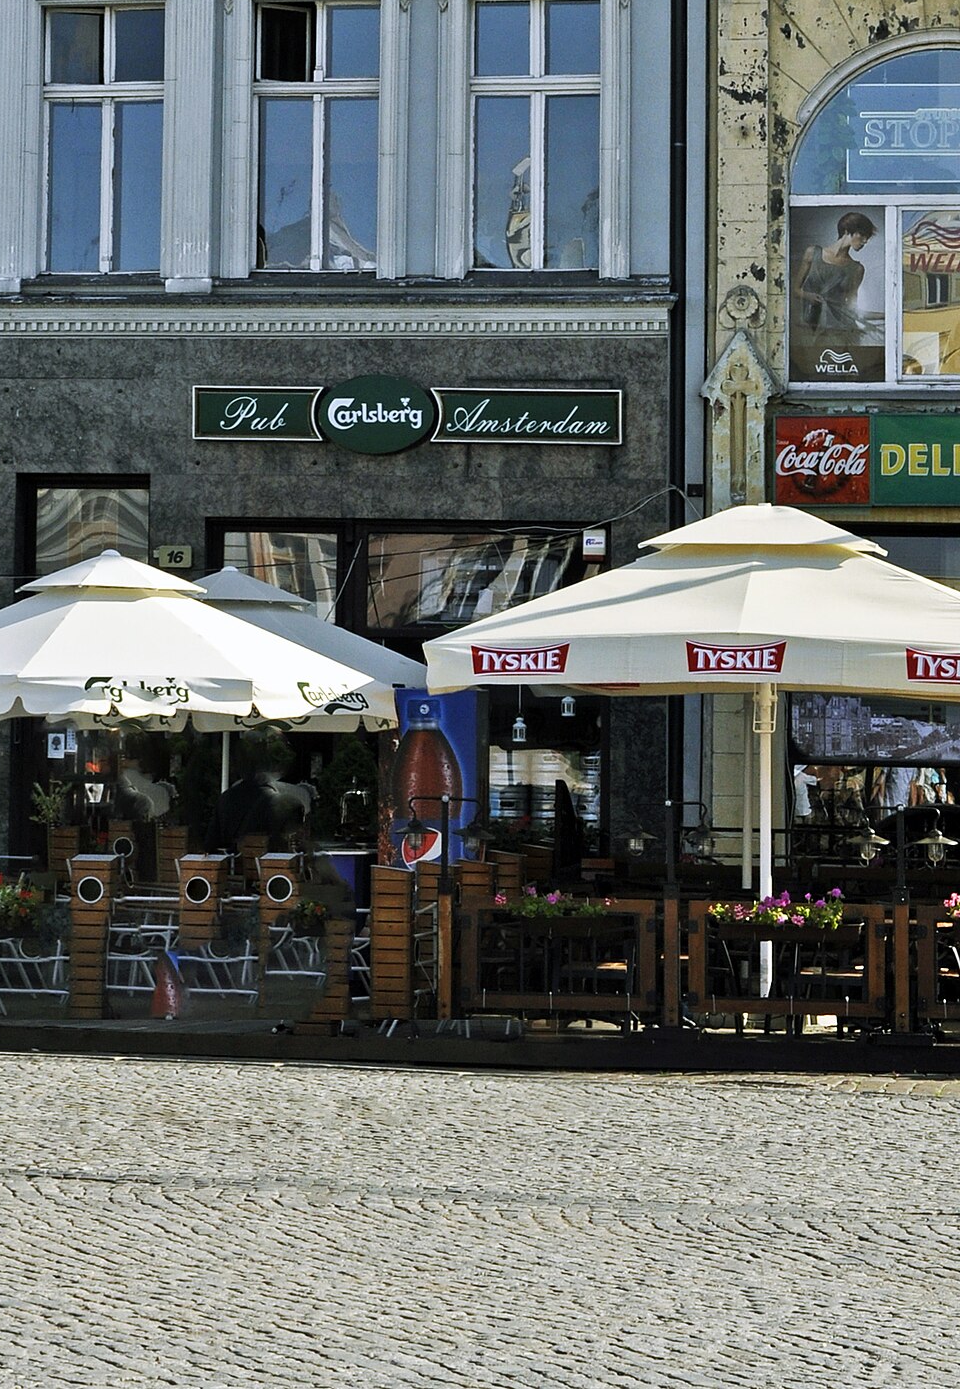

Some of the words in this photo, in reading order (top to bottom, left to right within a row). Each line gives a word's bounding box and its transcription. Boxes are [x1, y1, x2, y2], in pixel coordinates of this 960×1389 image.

[910, 253, 960, 272] WEL
[815, 364, 859, 373] WELLA
[219, 396, 289, 431] Pub
[327, 397, 423, 430] Carlsberg
[446, 398, 611, 435] Amsterdam
[775, 443, 870, 476] Coca-Cola
[167, 550, 185, 564] 16
[478, 649, 560, 671] TYSKIE
[693, 647, 777, 669] TYSKIE
